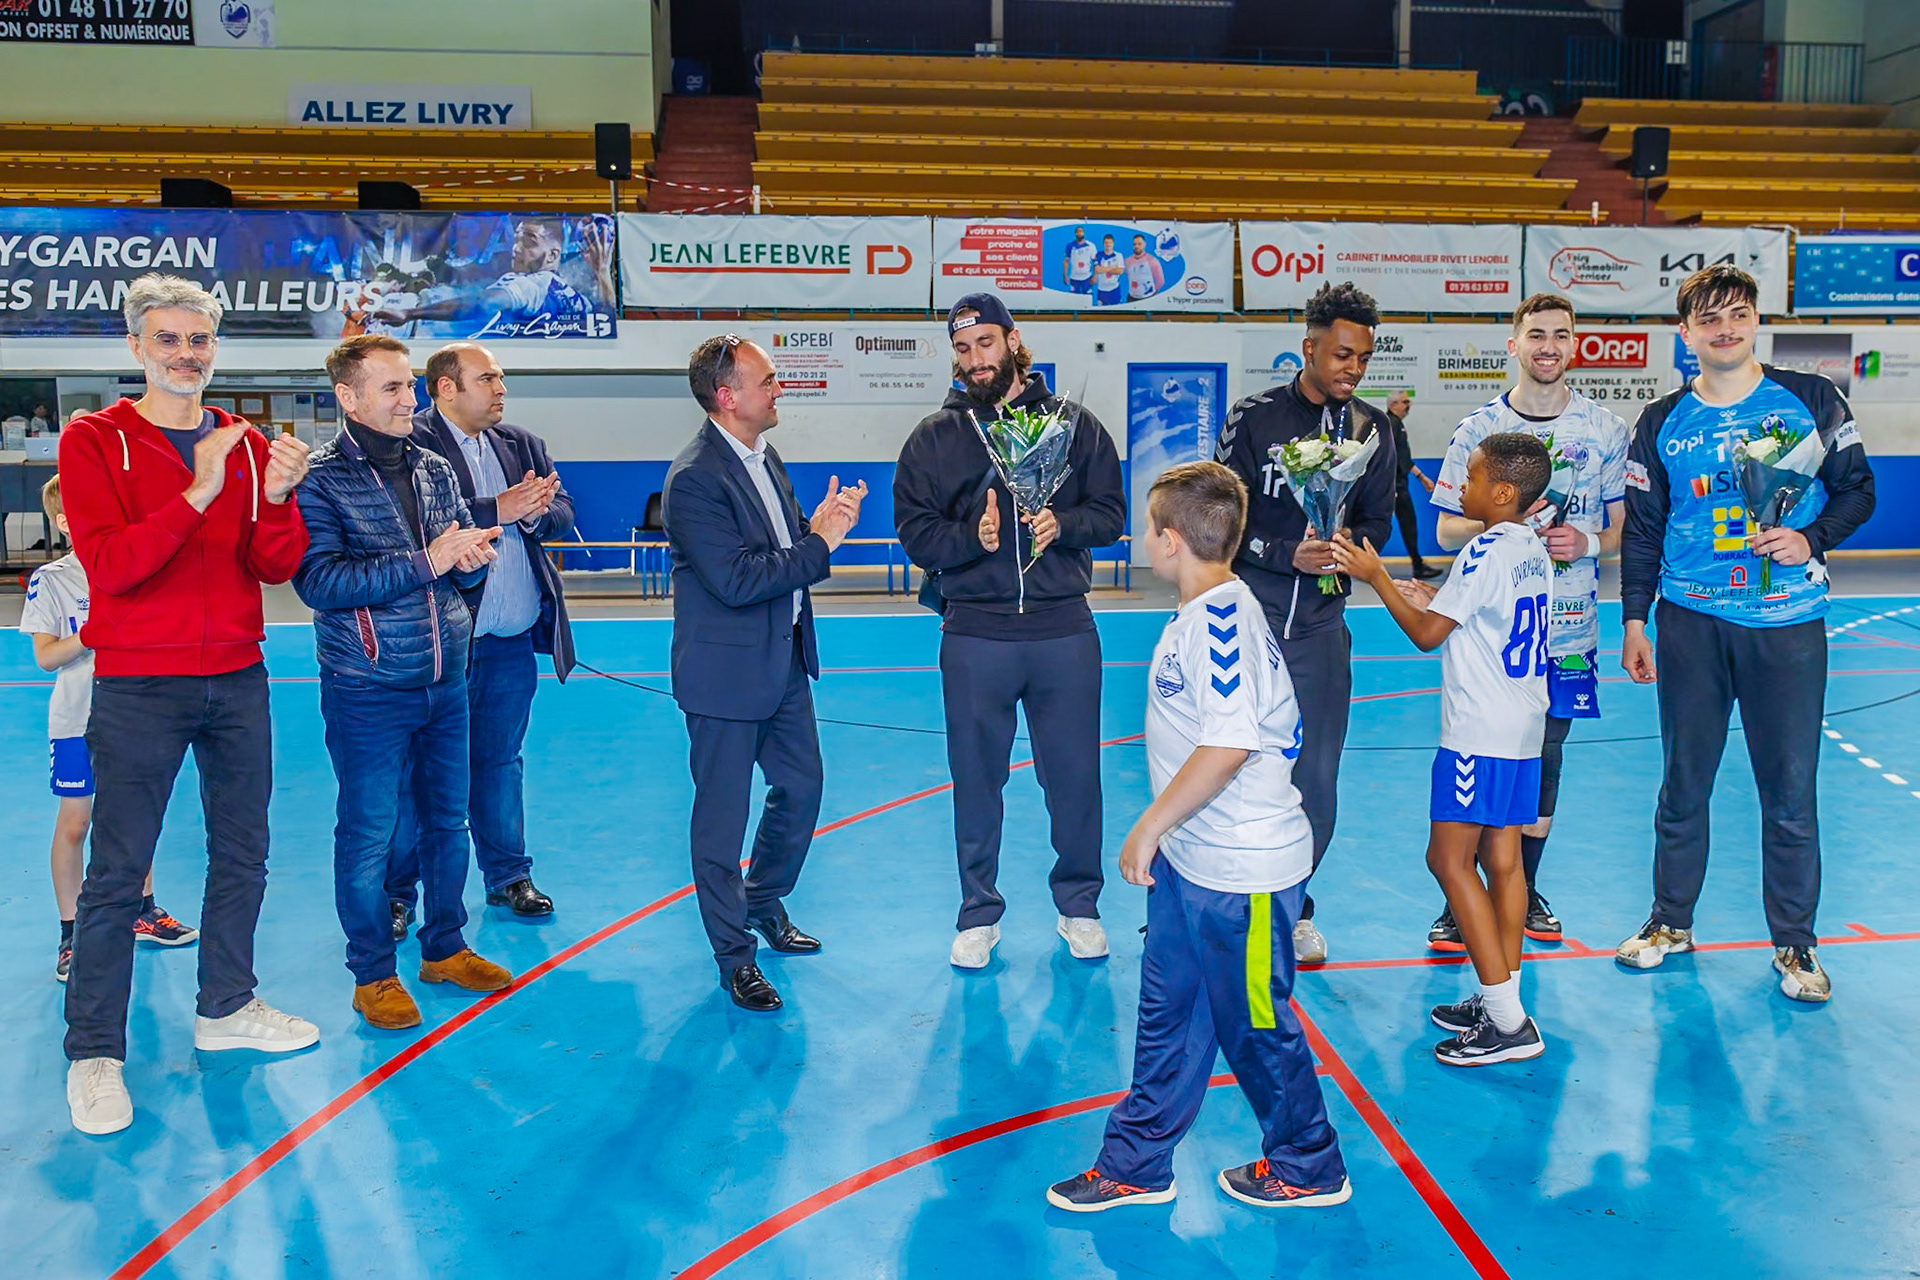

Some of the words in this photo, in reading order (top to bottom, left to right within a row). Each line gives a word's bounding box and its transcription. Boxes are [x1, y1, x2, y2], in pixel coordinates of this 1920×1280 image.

[38, 0, 61, 18] 01
[69, 0, 96, 18] 48
[104, 0, 125, 18] 11
[132, 0, 156, 18] 27
[163, 0, 188, 19] 70
[26, 22, 79, 39] OFFSET
[84, 24, 96, 39] &
[100, 19, 190, 40] NUMÉRIQUE
[301, 100, 406, 123] ALLEZ
[417, 102, 514, 125] LIVRY
[969, 227, 995, 236] votre
[996, 227, 1038, 237] magasin
[987, 241, 1023, 249] proche
[1025, 241, 1038, 249] de
[0, 235, 217, 269] Y-GARGAN
[649, 243, 713, 263] JEAN
[723, 244, 851, 264] LEFEBVRE
[1005, 253, 1038, 261] clients
[1251, 244, 1325, 283] Orpi
[1336, 252, 1379, 263] CABINET
[1381, 253, 1439, 263] IMMOBILIER
[1440, 254, 1467, 264] RIVET
[1469, 255, 1509, 264] LENOBLE
[952, 266, 963, 274] et
[965, 266, 981, 276] qui
[1008, 266, 1029, 275] livre
[997, 280, 1038, 288] domicile
[855, 336, 917, 355] Optimum
[1375, 336, 1398, 344] ASH
[1581, 335, 1645, 360] ORPI
[1438, 358, 1507, 369] BRIMBEUF
[777, 371, 786, 379] 01
[800, 371, 809, 379] 70
[810, 371, 818, 379] 21
[819, 371, 827, 379] 21
[1589, 388, 1607, 400] 30
[1613, 388, 1631, 400] 52
[1637, 388, 1655, 400] 63
[1666, 430, 1704, 456] Orpi
[1713, 552, 1747, 561] DUBRAC
[1688, 582, 1717, 597] JEAN
[1721, 584, 1788, 597] LEFEBVRE
[1552, 601, 1584, 612] EBVRE
[1736, 602, 1791, 611] FRANCE
[56, 778, 85, 788] hummel
